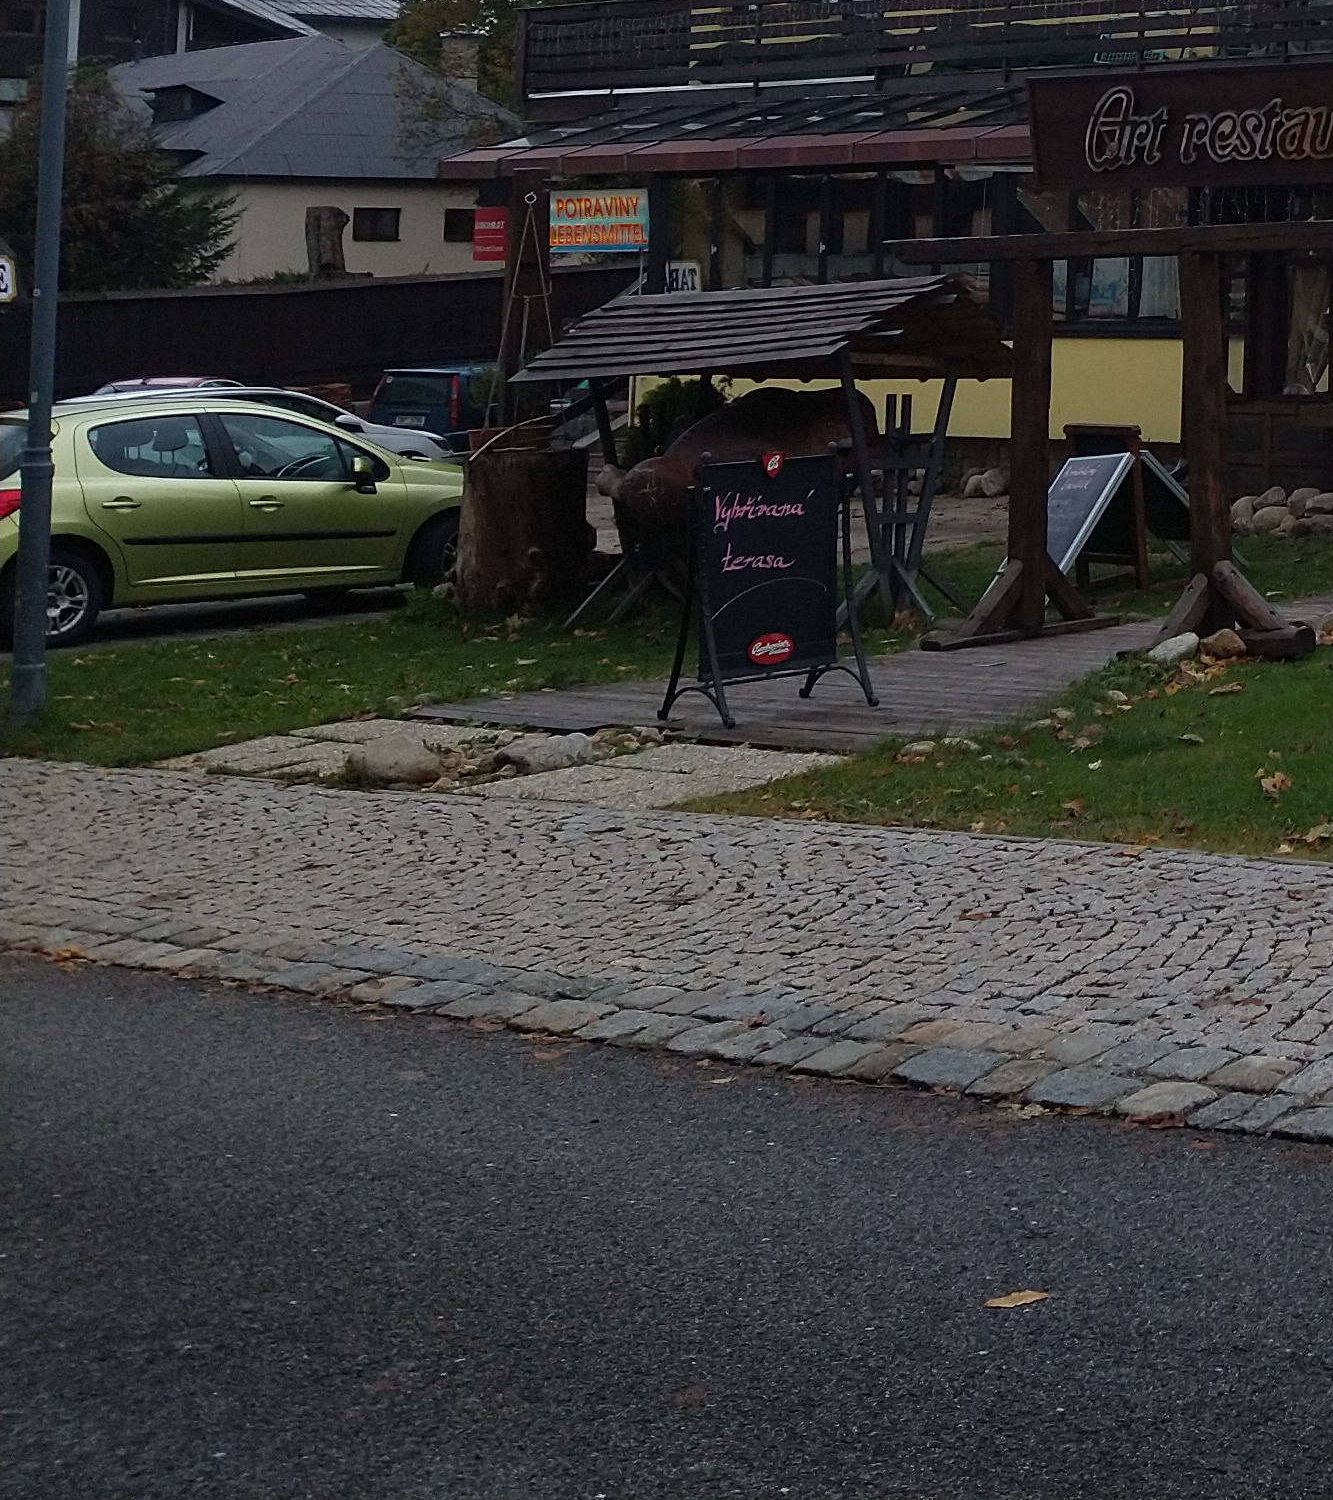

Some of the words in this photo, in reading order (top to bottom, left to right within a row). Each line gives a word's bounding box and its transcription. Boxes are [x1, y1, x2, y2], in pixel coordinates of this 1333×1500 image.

[1085, 85, 1169, 173] Art
[555, 196, 640, 219] POTRAVINY
[549, 223, 648, 245] LEBENSMITTEL
[720, 541, 797, 575] terasa
